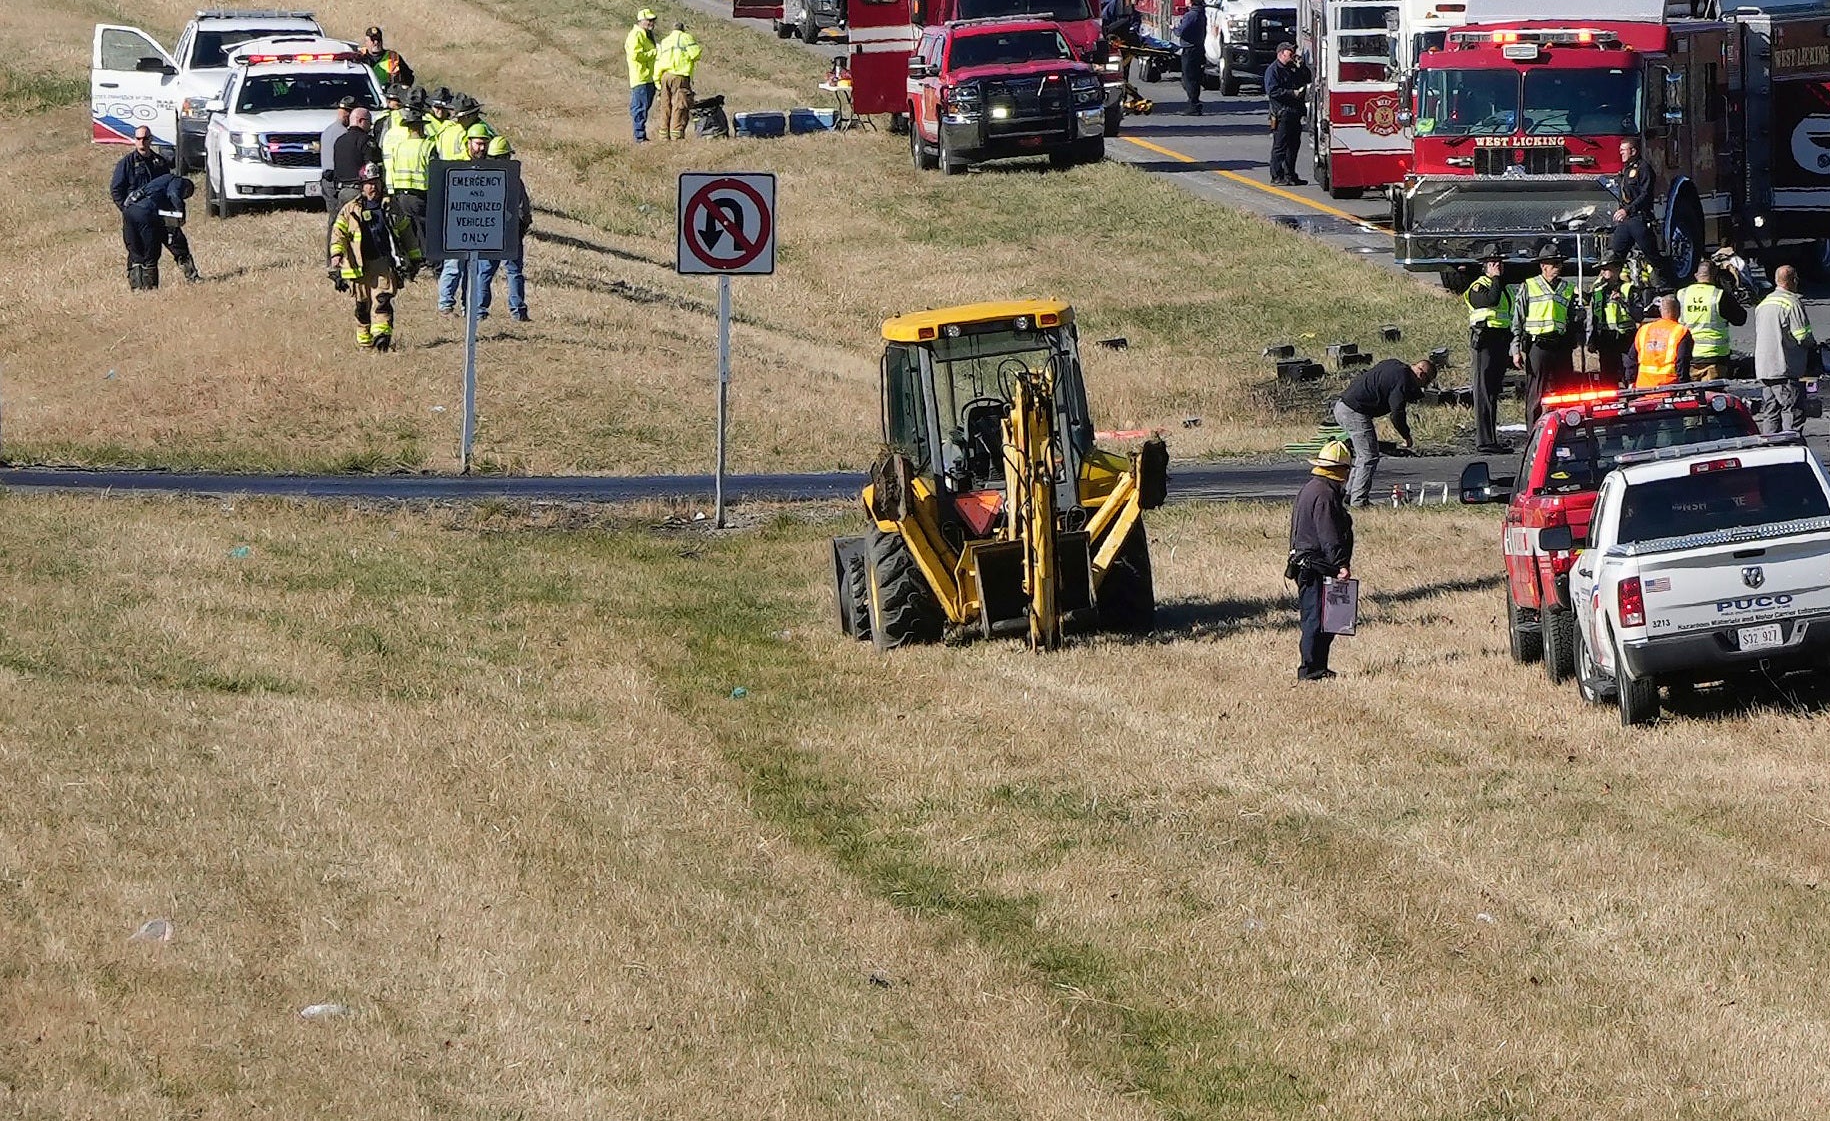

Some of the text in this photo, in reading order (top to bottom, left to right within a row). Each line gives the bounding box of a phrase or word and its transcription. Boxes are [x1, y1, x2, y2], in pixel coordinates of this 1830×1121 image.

[1774, 49, 1796, 68] WEST
[1797, 45, 1830, 67] LICKING
[1474, 136, 1565, 147] WEST LICKING
[452, 176, 502, 187] EMERGENCY
[450, 201, 502, 212] AUTHORIZED
[456, 216, 496, 227] VEHICLES
[461, 232, 489, 243] ONLY
[1716, 594, 1793, 612] PUCO
[1652, 619, 1671, 628] 3213
[1677, 621, 1711, 631] Hazardous
[1711, 617, 1741, 626] Materials
[1755, 612, 1774, 621] Motor
[1774, 609, 1796, 618] Carrier
[1762, 630, 1777, 642] 927
